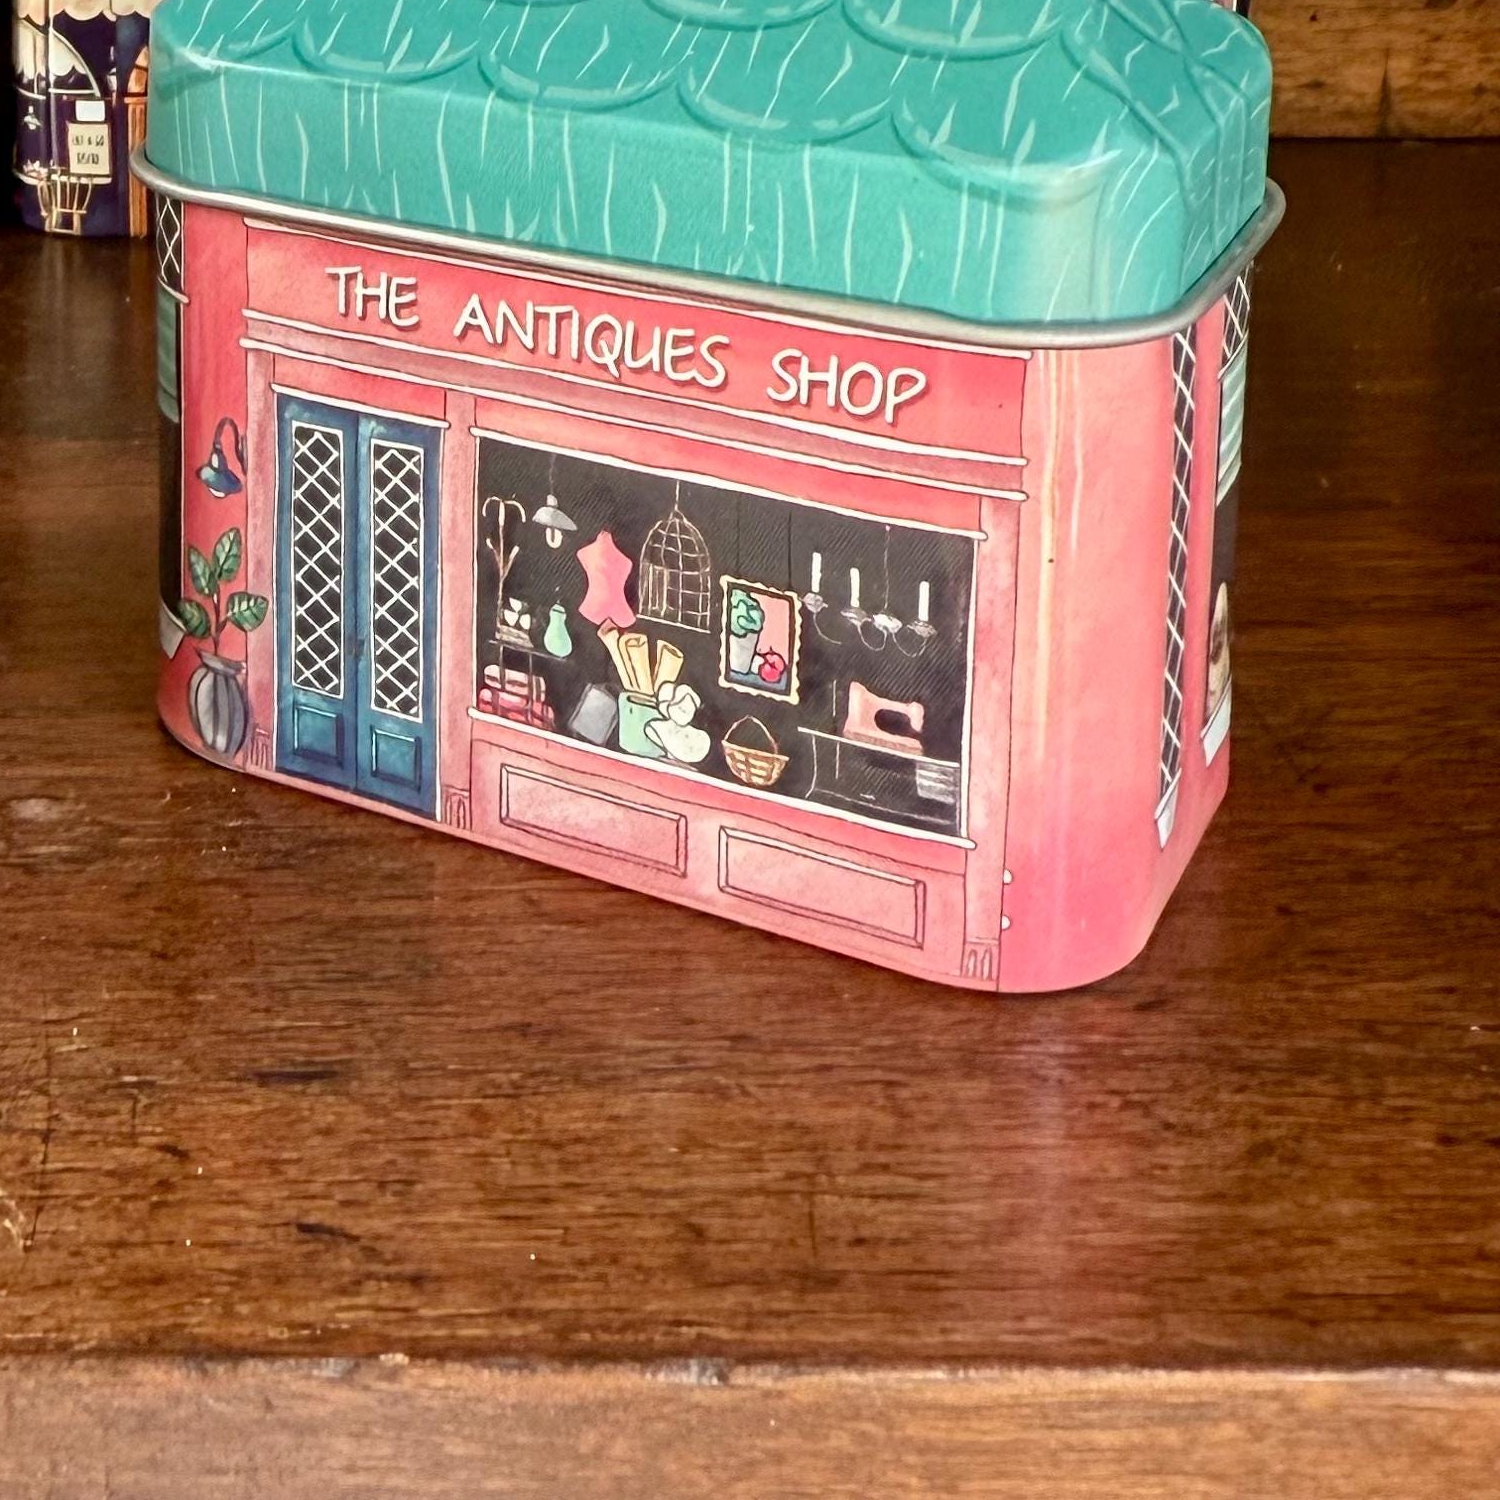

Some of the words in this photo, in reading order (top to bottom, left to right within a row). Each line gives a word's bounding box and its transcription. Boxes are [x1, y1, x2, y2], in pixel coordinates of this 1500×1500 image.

[325, 265, 420, 328] THE
[452, 293, 730, 390] ANTIQUES
[765, 347, 928, 426] SHOP
